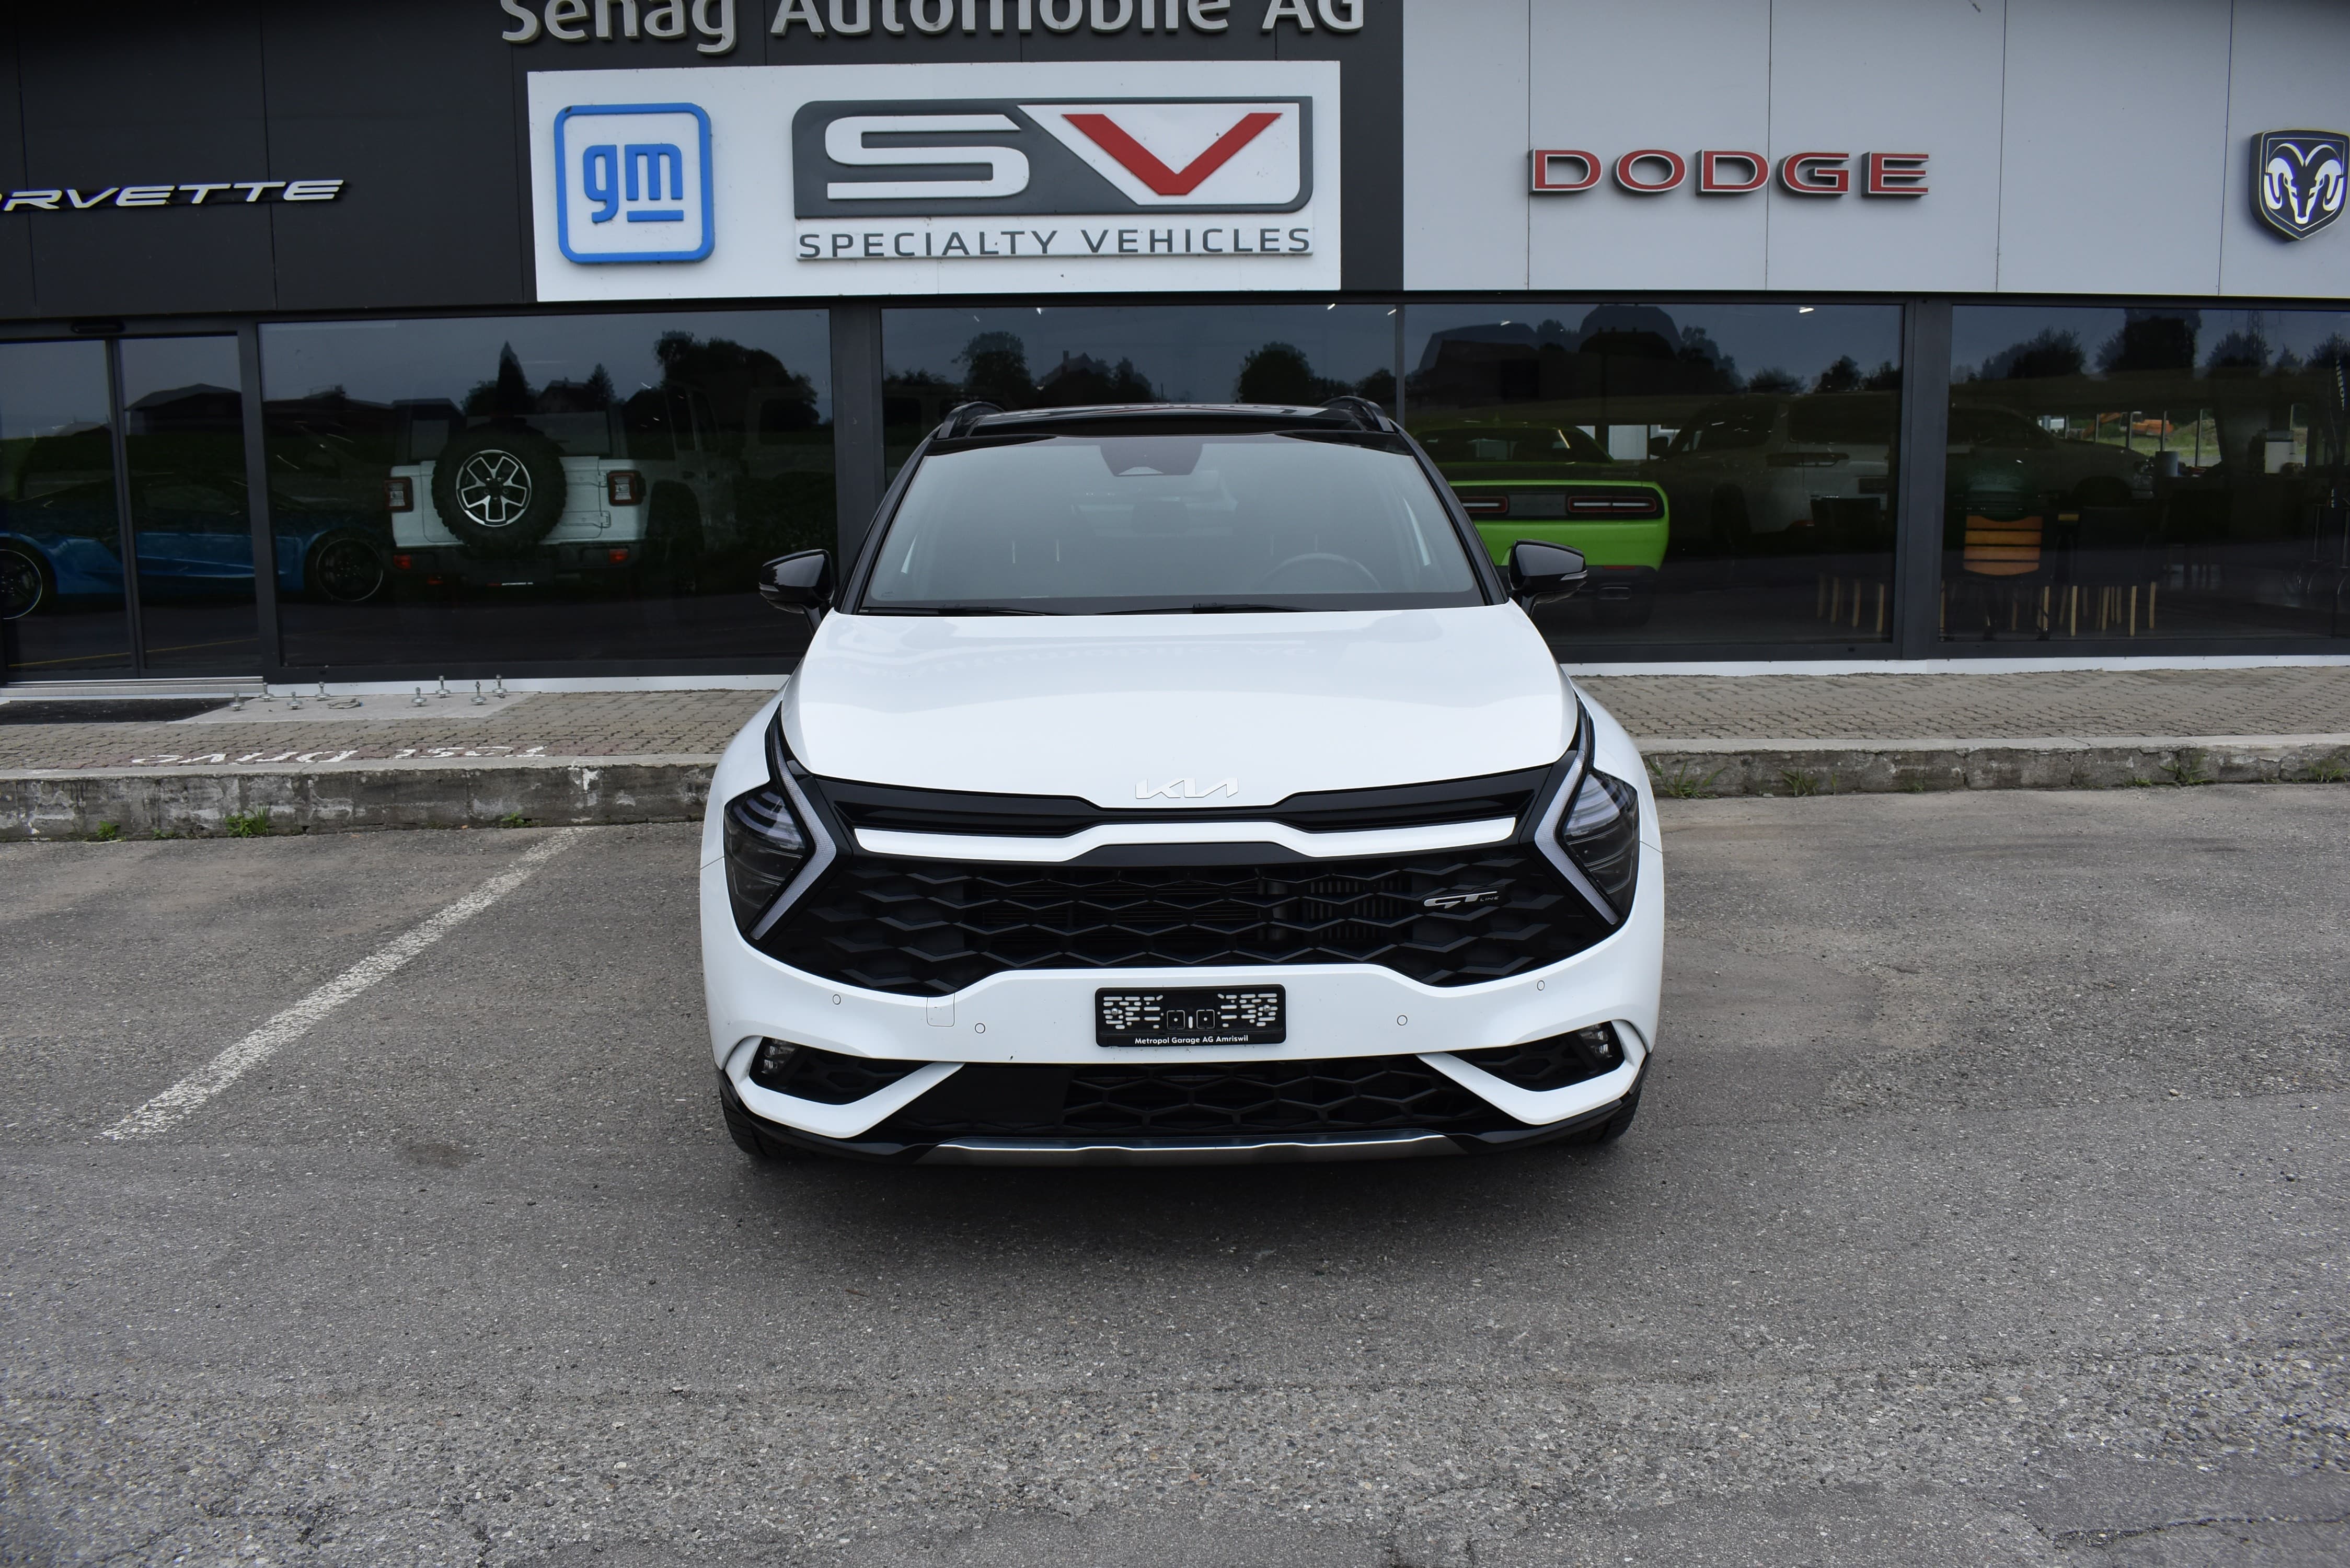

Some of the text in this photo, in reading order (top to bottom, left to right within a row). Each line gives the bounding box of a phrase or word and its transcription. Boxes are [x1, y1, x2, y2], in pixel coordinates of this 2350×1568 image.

[1528, 148, 1930, 196] DODGE
[0, 179, 344, 211] RVETTE
[799, 227, 1310, 259] SPECIALTY VEHICLES
[1135, 777, 1239, 800] KIA
[1423, 891, 1498, 909] GT
[1135, 1036, 1170, 1045] Metropol
[1216, 1034, 1249, 1043] Amriswil
